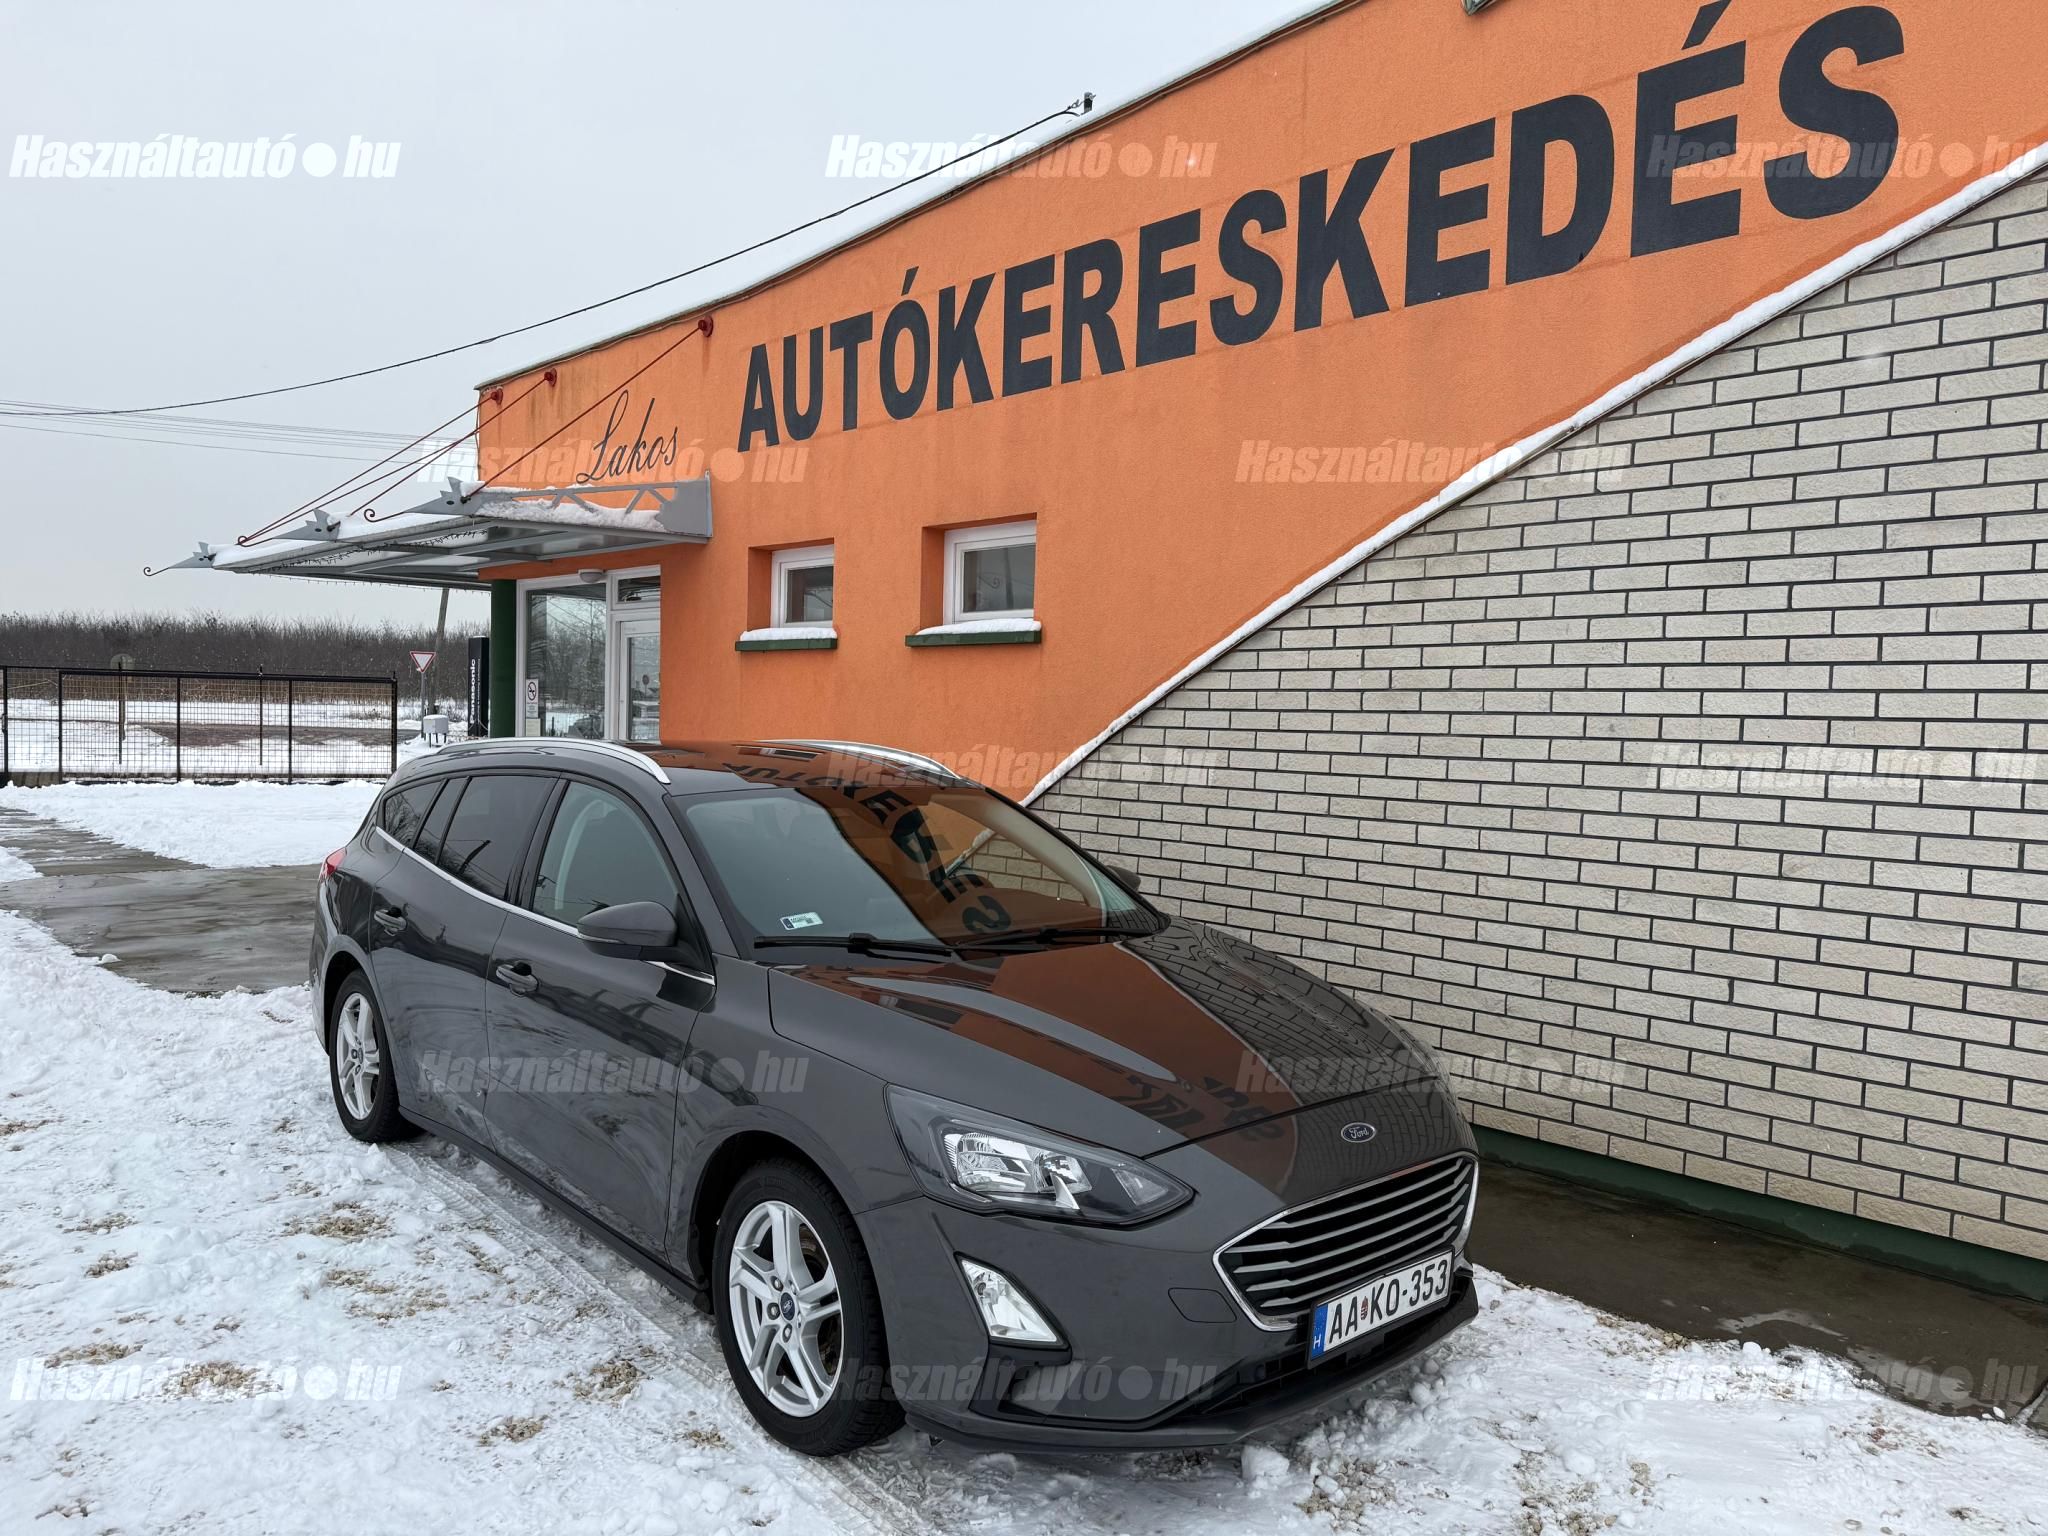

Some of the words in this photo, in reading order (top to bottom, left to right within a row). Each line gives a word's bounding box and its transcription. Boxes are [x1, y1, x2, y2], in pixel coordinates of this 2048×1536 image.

[737, 0, 1905, 452] AUTÓKERESKEDÉS
[576, 390, 679, 484] Lakos
[1313, 1334, 1322, 1350] H
